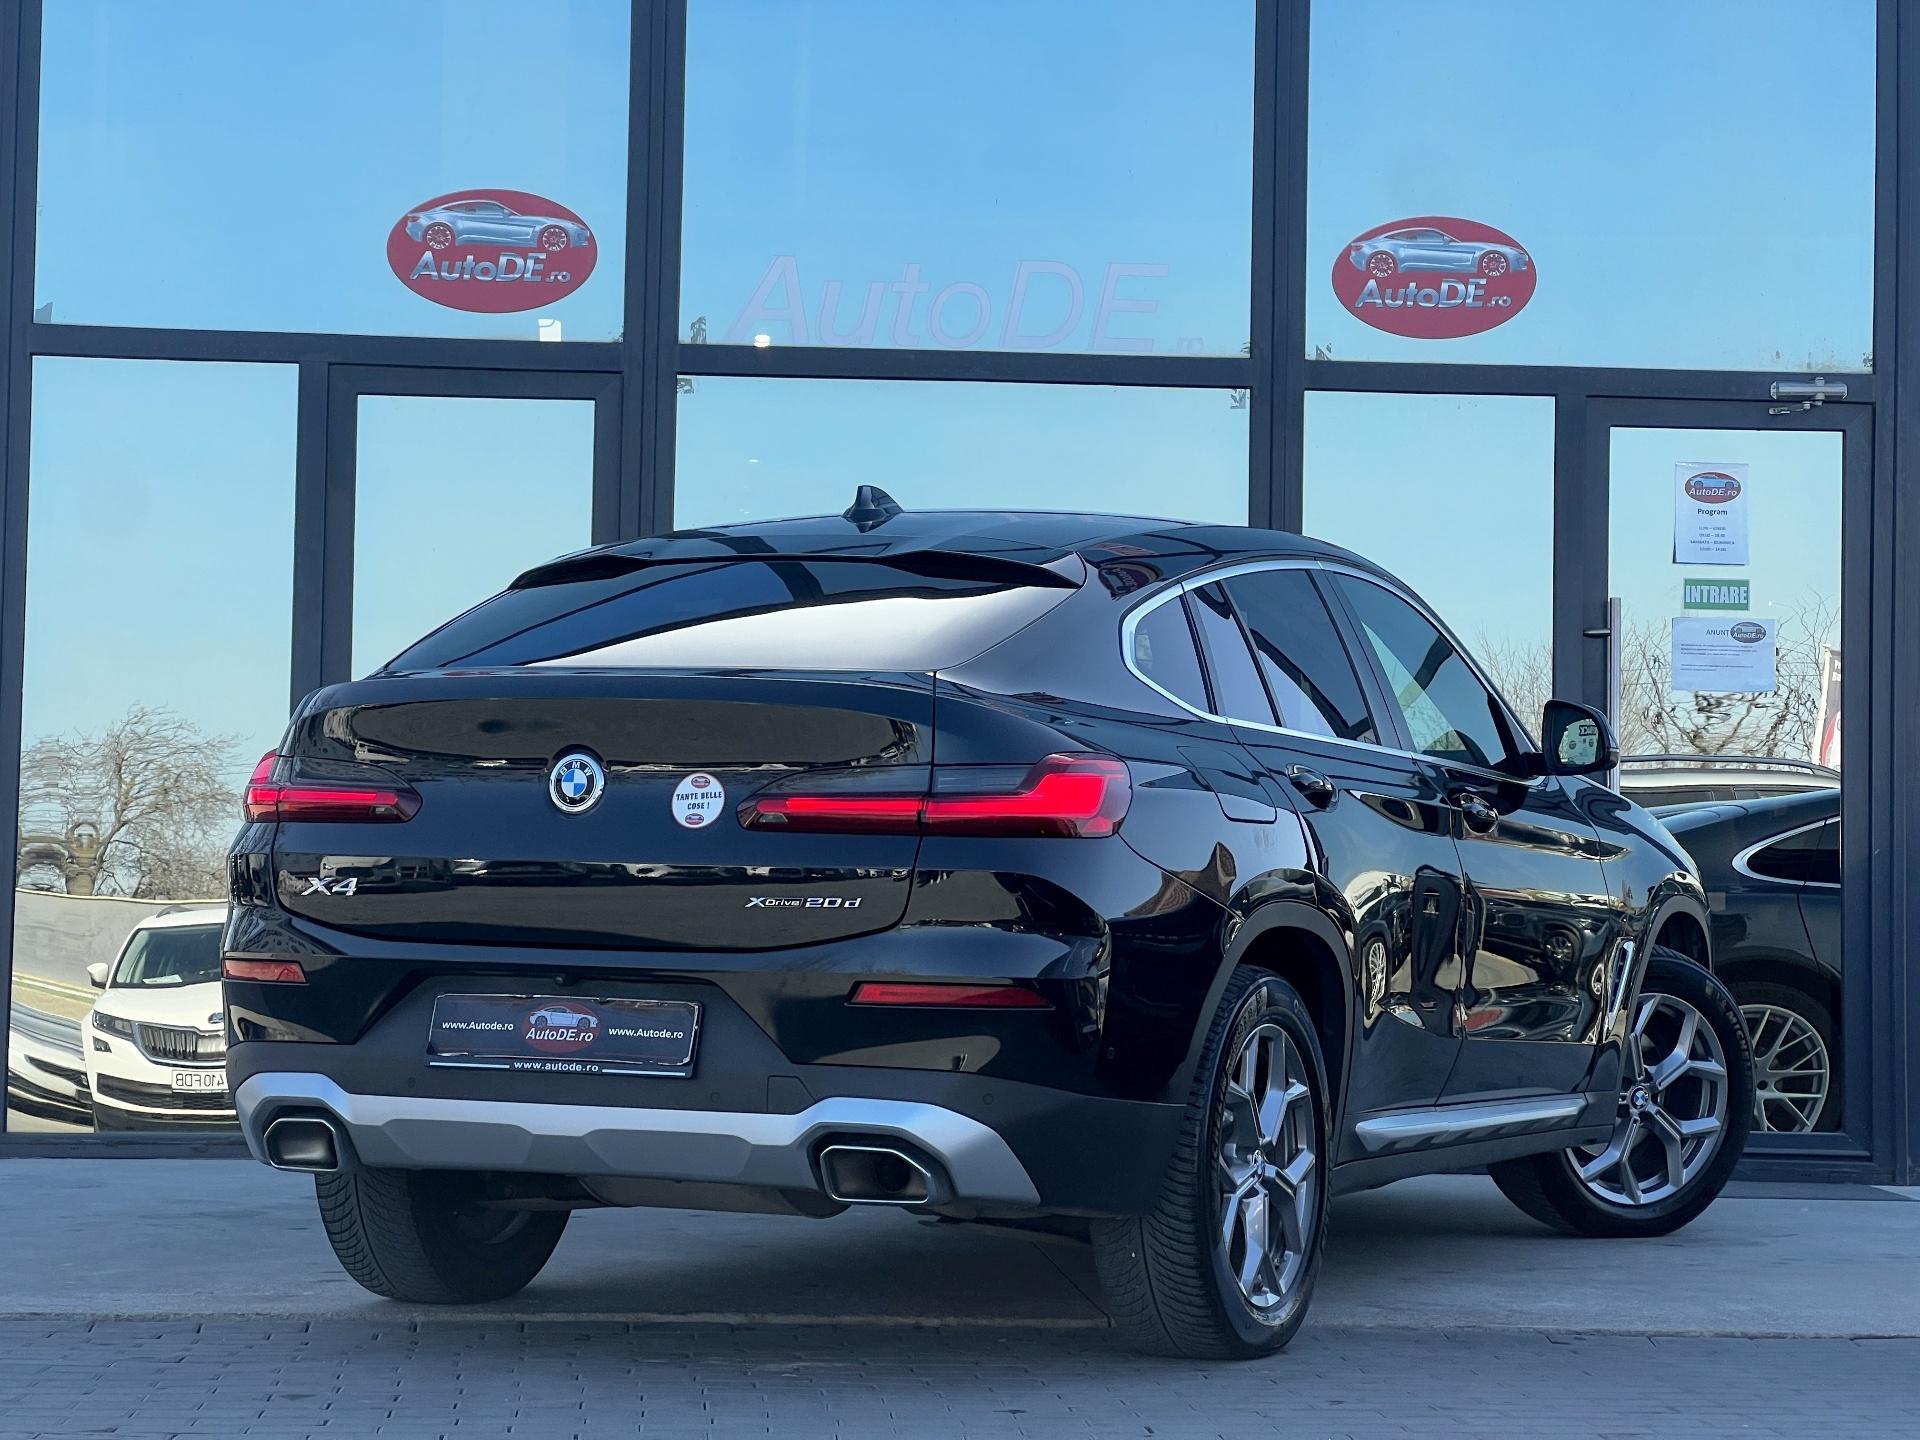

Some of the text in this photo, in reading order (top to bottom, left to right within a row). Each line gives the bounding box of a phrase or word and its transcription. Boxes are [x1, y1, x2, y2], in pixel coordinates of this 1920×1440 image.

[1697, 508, 1728, 517] Program
[1685, 585, 1748, 604] INTRARE
[676, 791, 723, 801] TANTE BELLE
[687, 802, 705, 810] COSE
[300, 877, 358, 896] X4
[442, 1021, 514, 1031] www.Autode.ro
[525, 1027, 594, 1042] AutoDE.ro
[608, 1028, 684, 1039] www.Autode.ro
[513, 1062, 599, 1072] www.autode.ro
